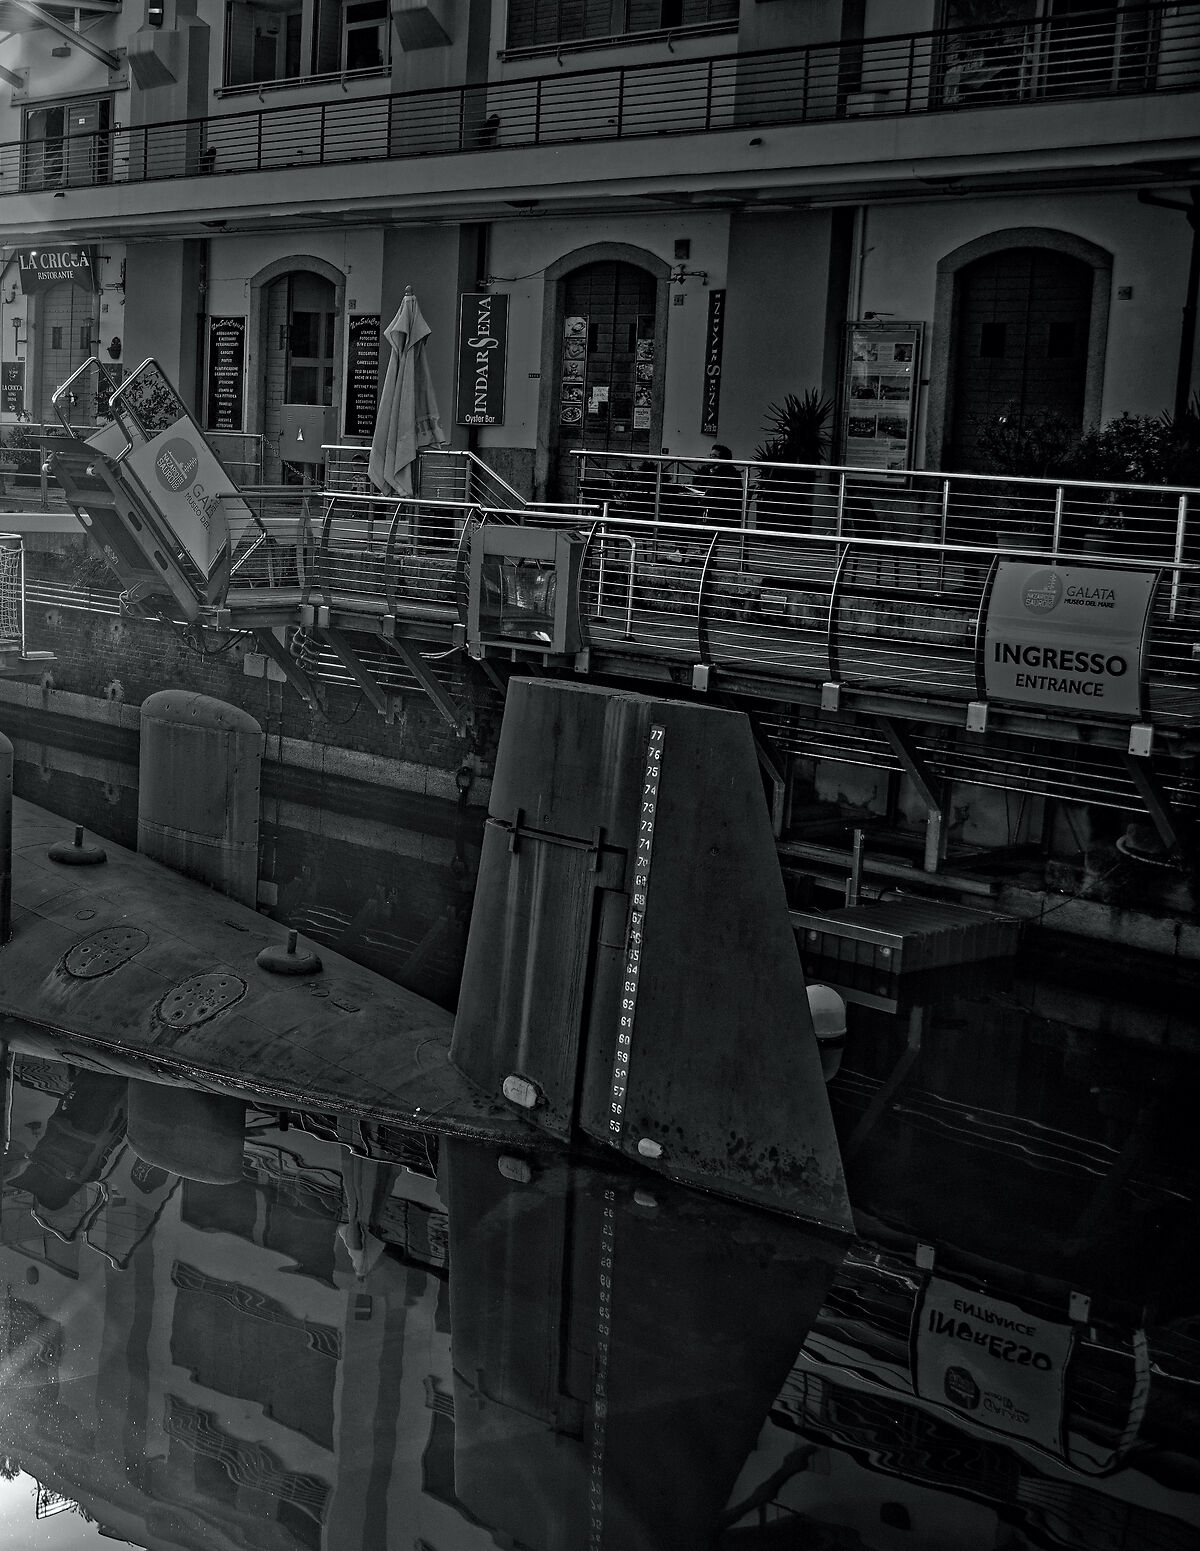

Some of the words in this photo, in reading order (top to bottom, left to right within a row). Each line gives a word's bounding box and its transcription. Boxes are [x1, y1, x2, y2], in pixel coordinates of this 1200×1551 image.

[19, 255, 38, 270] LA
[40, 251, 90, 270] CRICCA
[37, 270, 74, 280] RISTORANTE
[467, 296, 499, 414] INDARSENA
[464, 414, 484, 424] Oyster
[485, 414, 495, 423] Bar
[184, 492, 202, 516] MUSEO
[1066, 586, 1115, 601] GALATA
[994, 642, 1127, 676] INGRESSO
[1016, 673, 1104, 697] ENTRANCE
[651, 731, 662, 741] 77
[648, 747, 660, 760] 76
[646, 766, 658, 777] 75
[644, 785, 656, 794] 74
[642, 803, 654, 813] 73
[641, 821, 652, 831] 72
[639, 839, 650, 850] 71
[637, 857, 648, 866] 70
[632, 913, 643, 924] 67
[627, 964, 637, 974] 64
[625, 982, 636, 992] 63
[622, 999, 634, 1010] 62
[620, 1017, 631, 1027] 61
[619, 1034, 630, 1045] 60
[613, 1086, 624, 1097] 57
[611, 1103, 622, 1114] 56
[609, 1120, 620, 1133] 55
